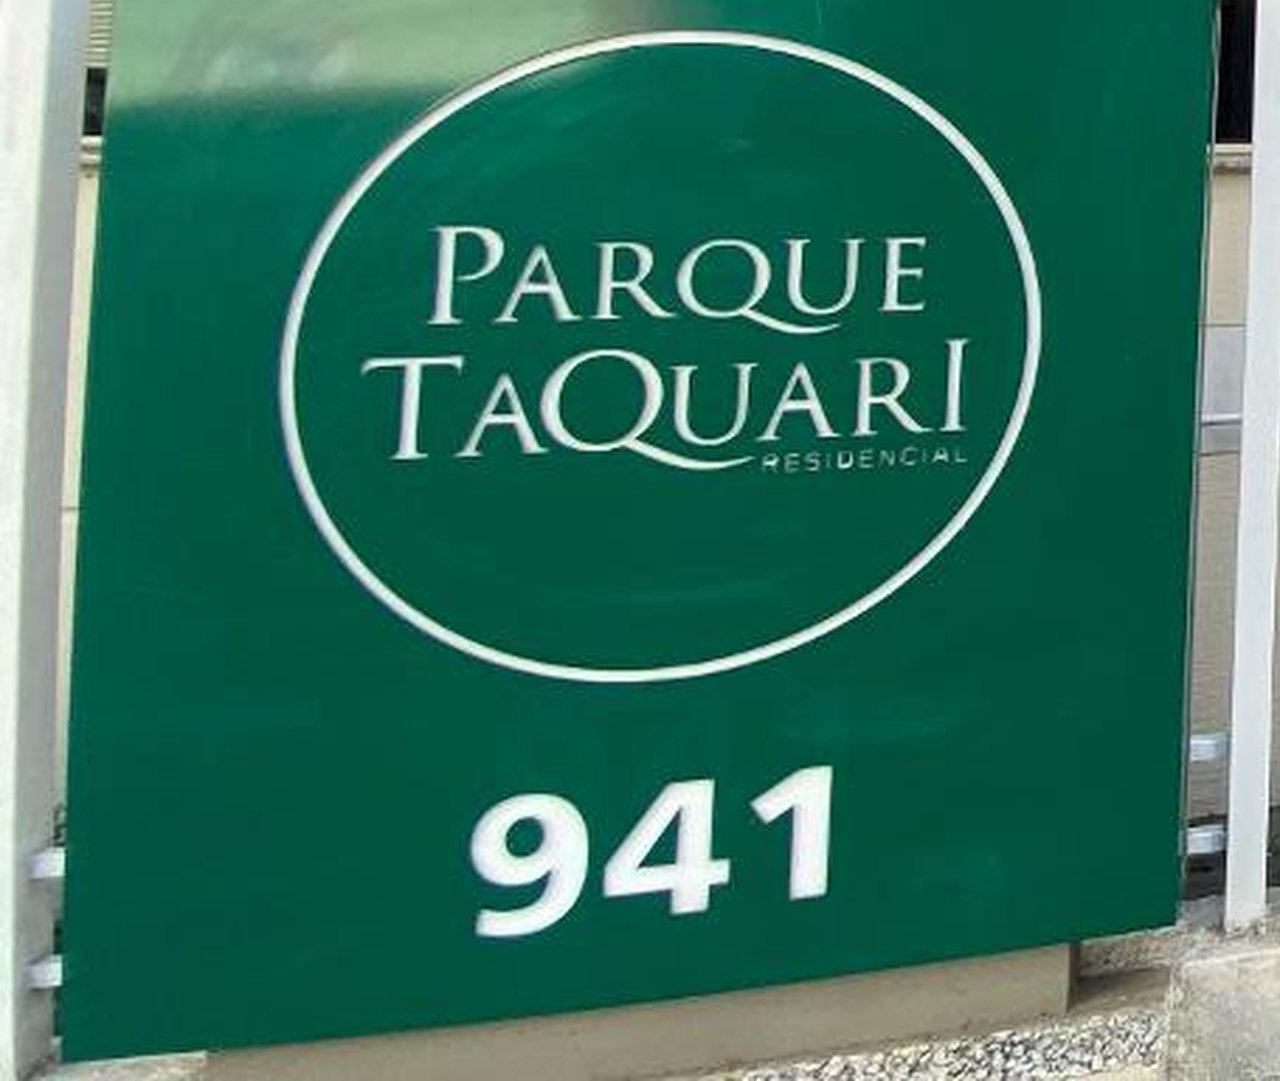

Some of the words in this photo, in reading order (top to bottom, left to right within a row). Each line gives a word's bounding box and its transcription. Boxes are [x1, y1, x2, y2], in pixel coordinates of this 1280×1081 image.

[426, 224, 928, 334] PARQUE
[360, 338, 970, 470] TAQUARI
[761, 447, 969, 471] RESIDENCIAL
[470, 765, 834, 937] 941
